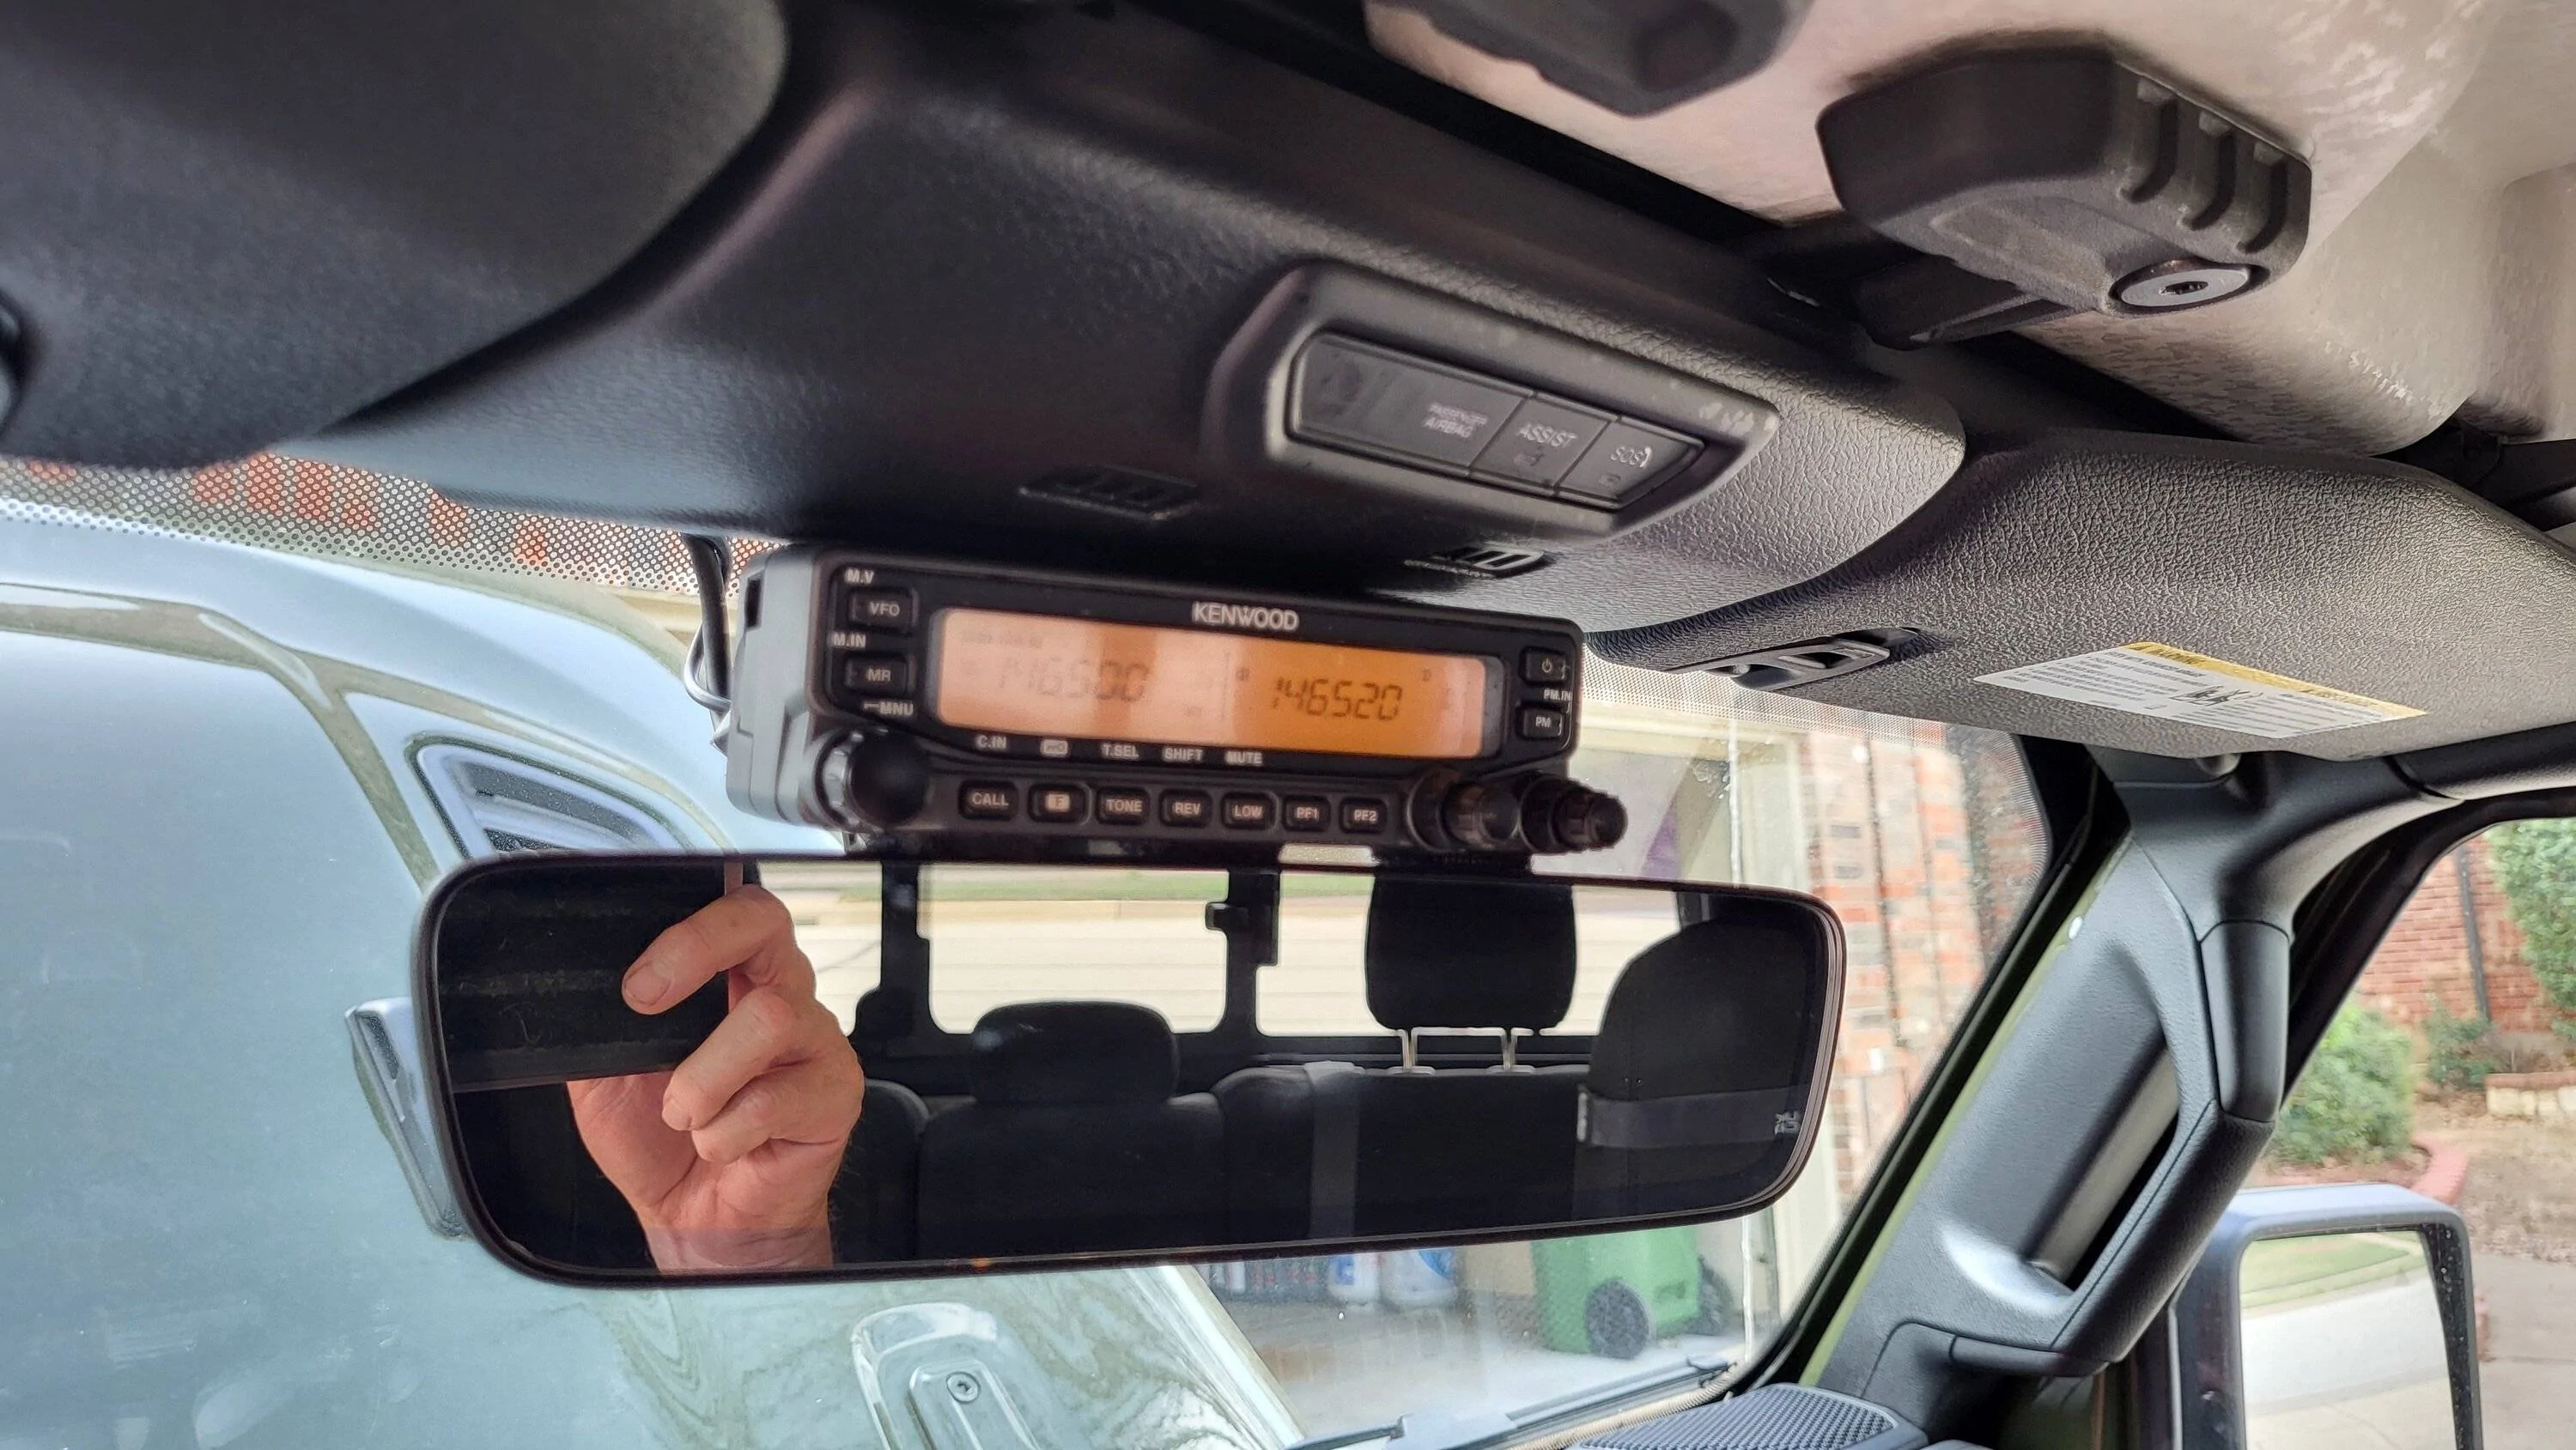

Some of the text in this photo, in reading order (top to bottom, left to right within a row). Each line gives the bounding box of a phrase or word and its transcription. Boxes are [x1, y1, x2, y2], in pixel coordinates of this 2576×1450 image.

[1517, 423, 1578, 447] ASSIST
[1610, 446, 1643, 466] SOS
[869, 602, 900, 616] VFO
[1192, 601, 1299, 631] KENWOOD
[832, 632, 866, 647] M.IN
[866, 668, 891, 683] MR
[1543, 689, 1572, 701] PM.IN
[1535, 715, 1552, 728] PM
[975, 735, 1007, 749] C.IN
[1102, 743, 1139, 760] T.SEL
[1163, 748, 1204, 763] SHIFT
[1225, 750, 1263, 766] MUTE
[970, 792, 1009, 808] CALL
[1106, 798, 1143, 813] TONE
[1173, 801, 1201, 816] REV
[1232, 804, 1264, 819] LOW
[1296, 806, 1320, 821] PF1
[1352, 809, 1379, 824] PF2
